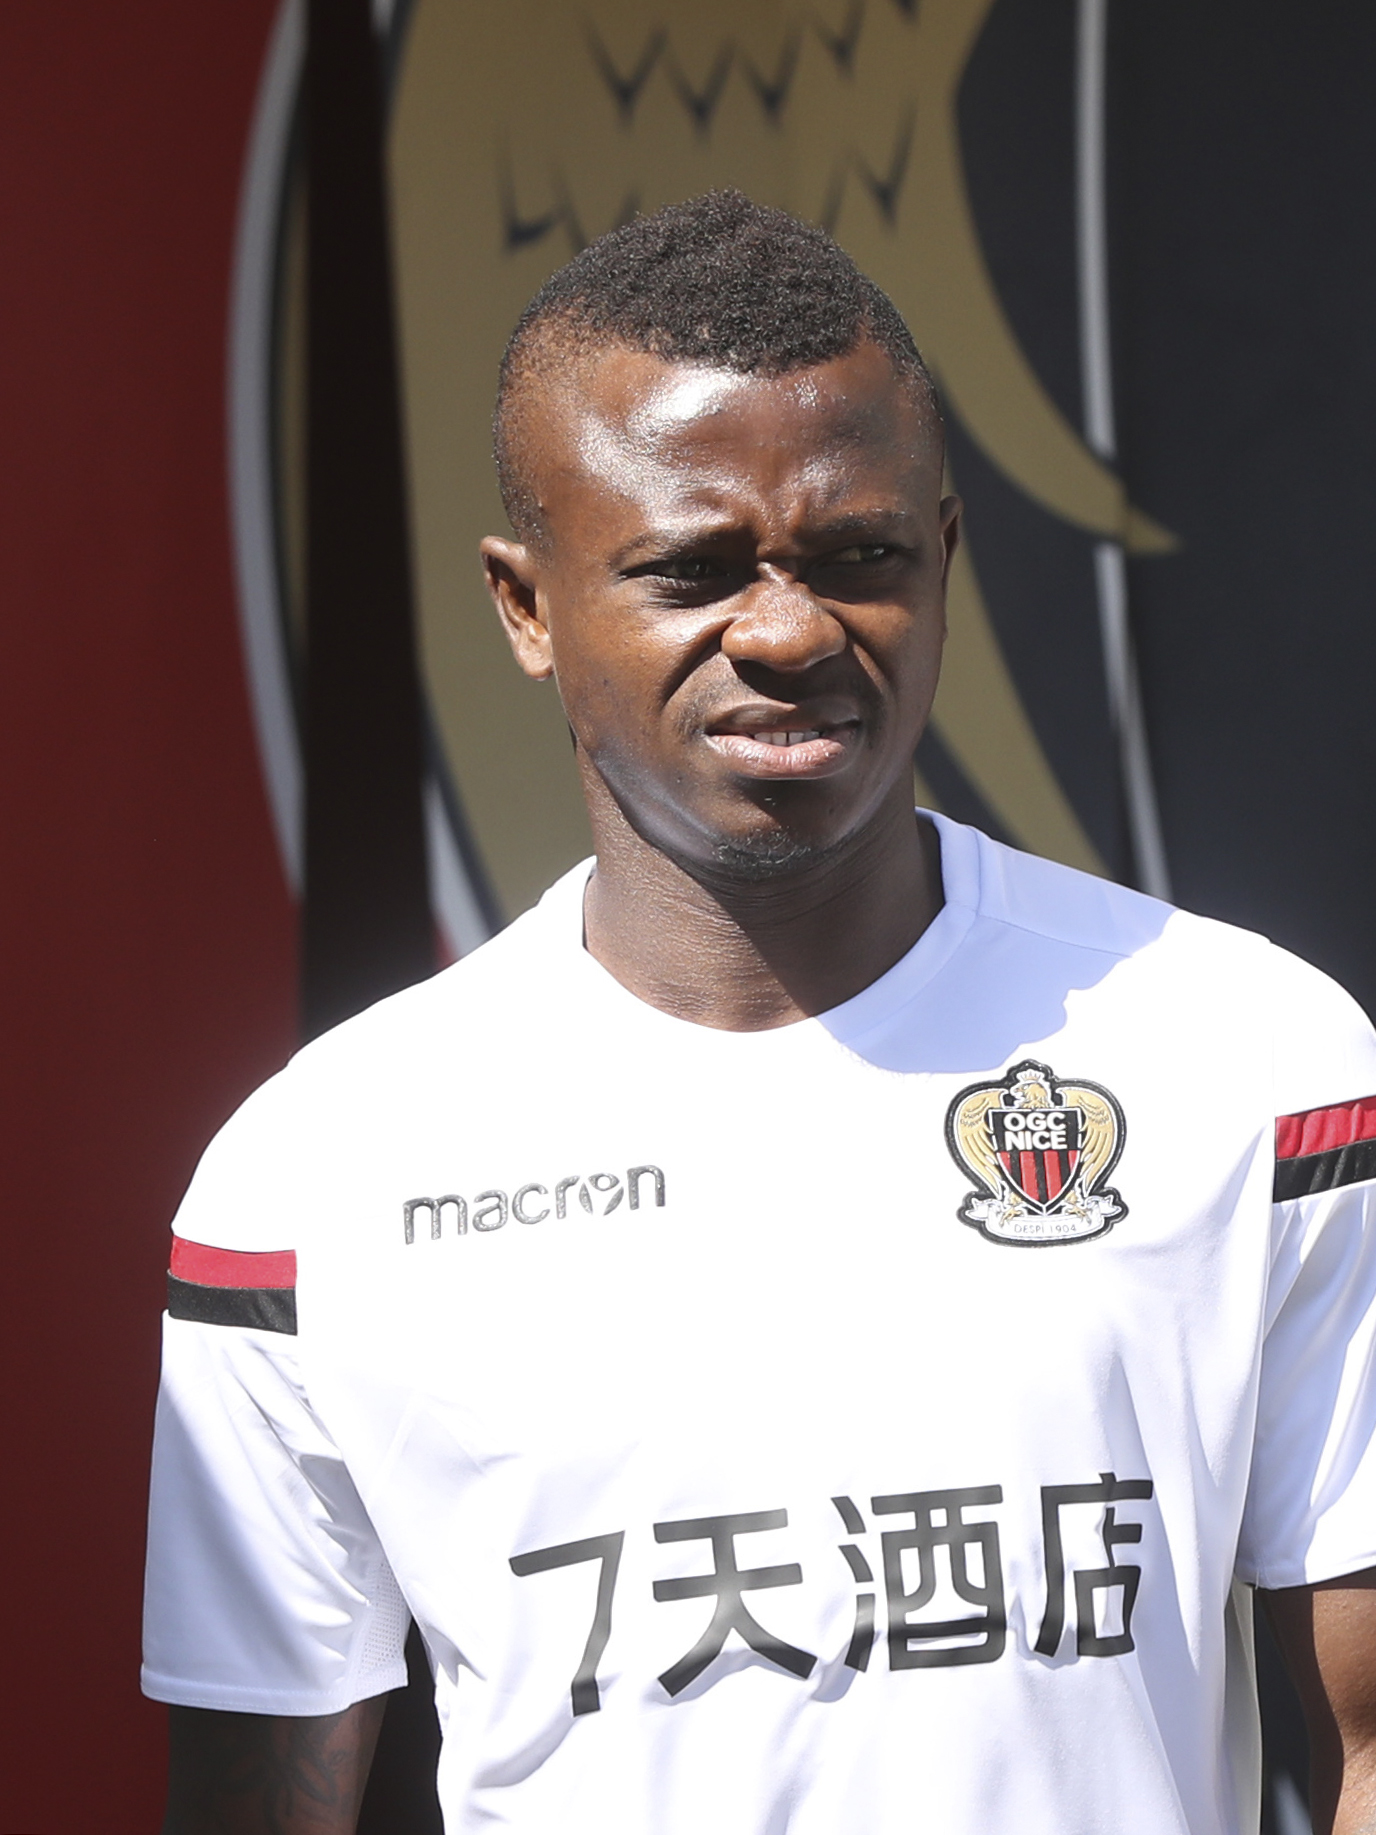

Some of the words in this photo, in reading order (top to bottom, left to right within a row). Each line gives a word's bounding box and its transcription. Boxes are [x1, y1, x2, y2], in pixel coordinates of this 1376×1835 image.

[1003, 1111, 1065, 1131] OGC
[1005, 1131, 1068, 1150] NICE
[402, 1164, 666, 1245] macron
[1050, 1224, 1077, 1233] 1904
[508, 1472, 1154, 1716] 7天酒店
